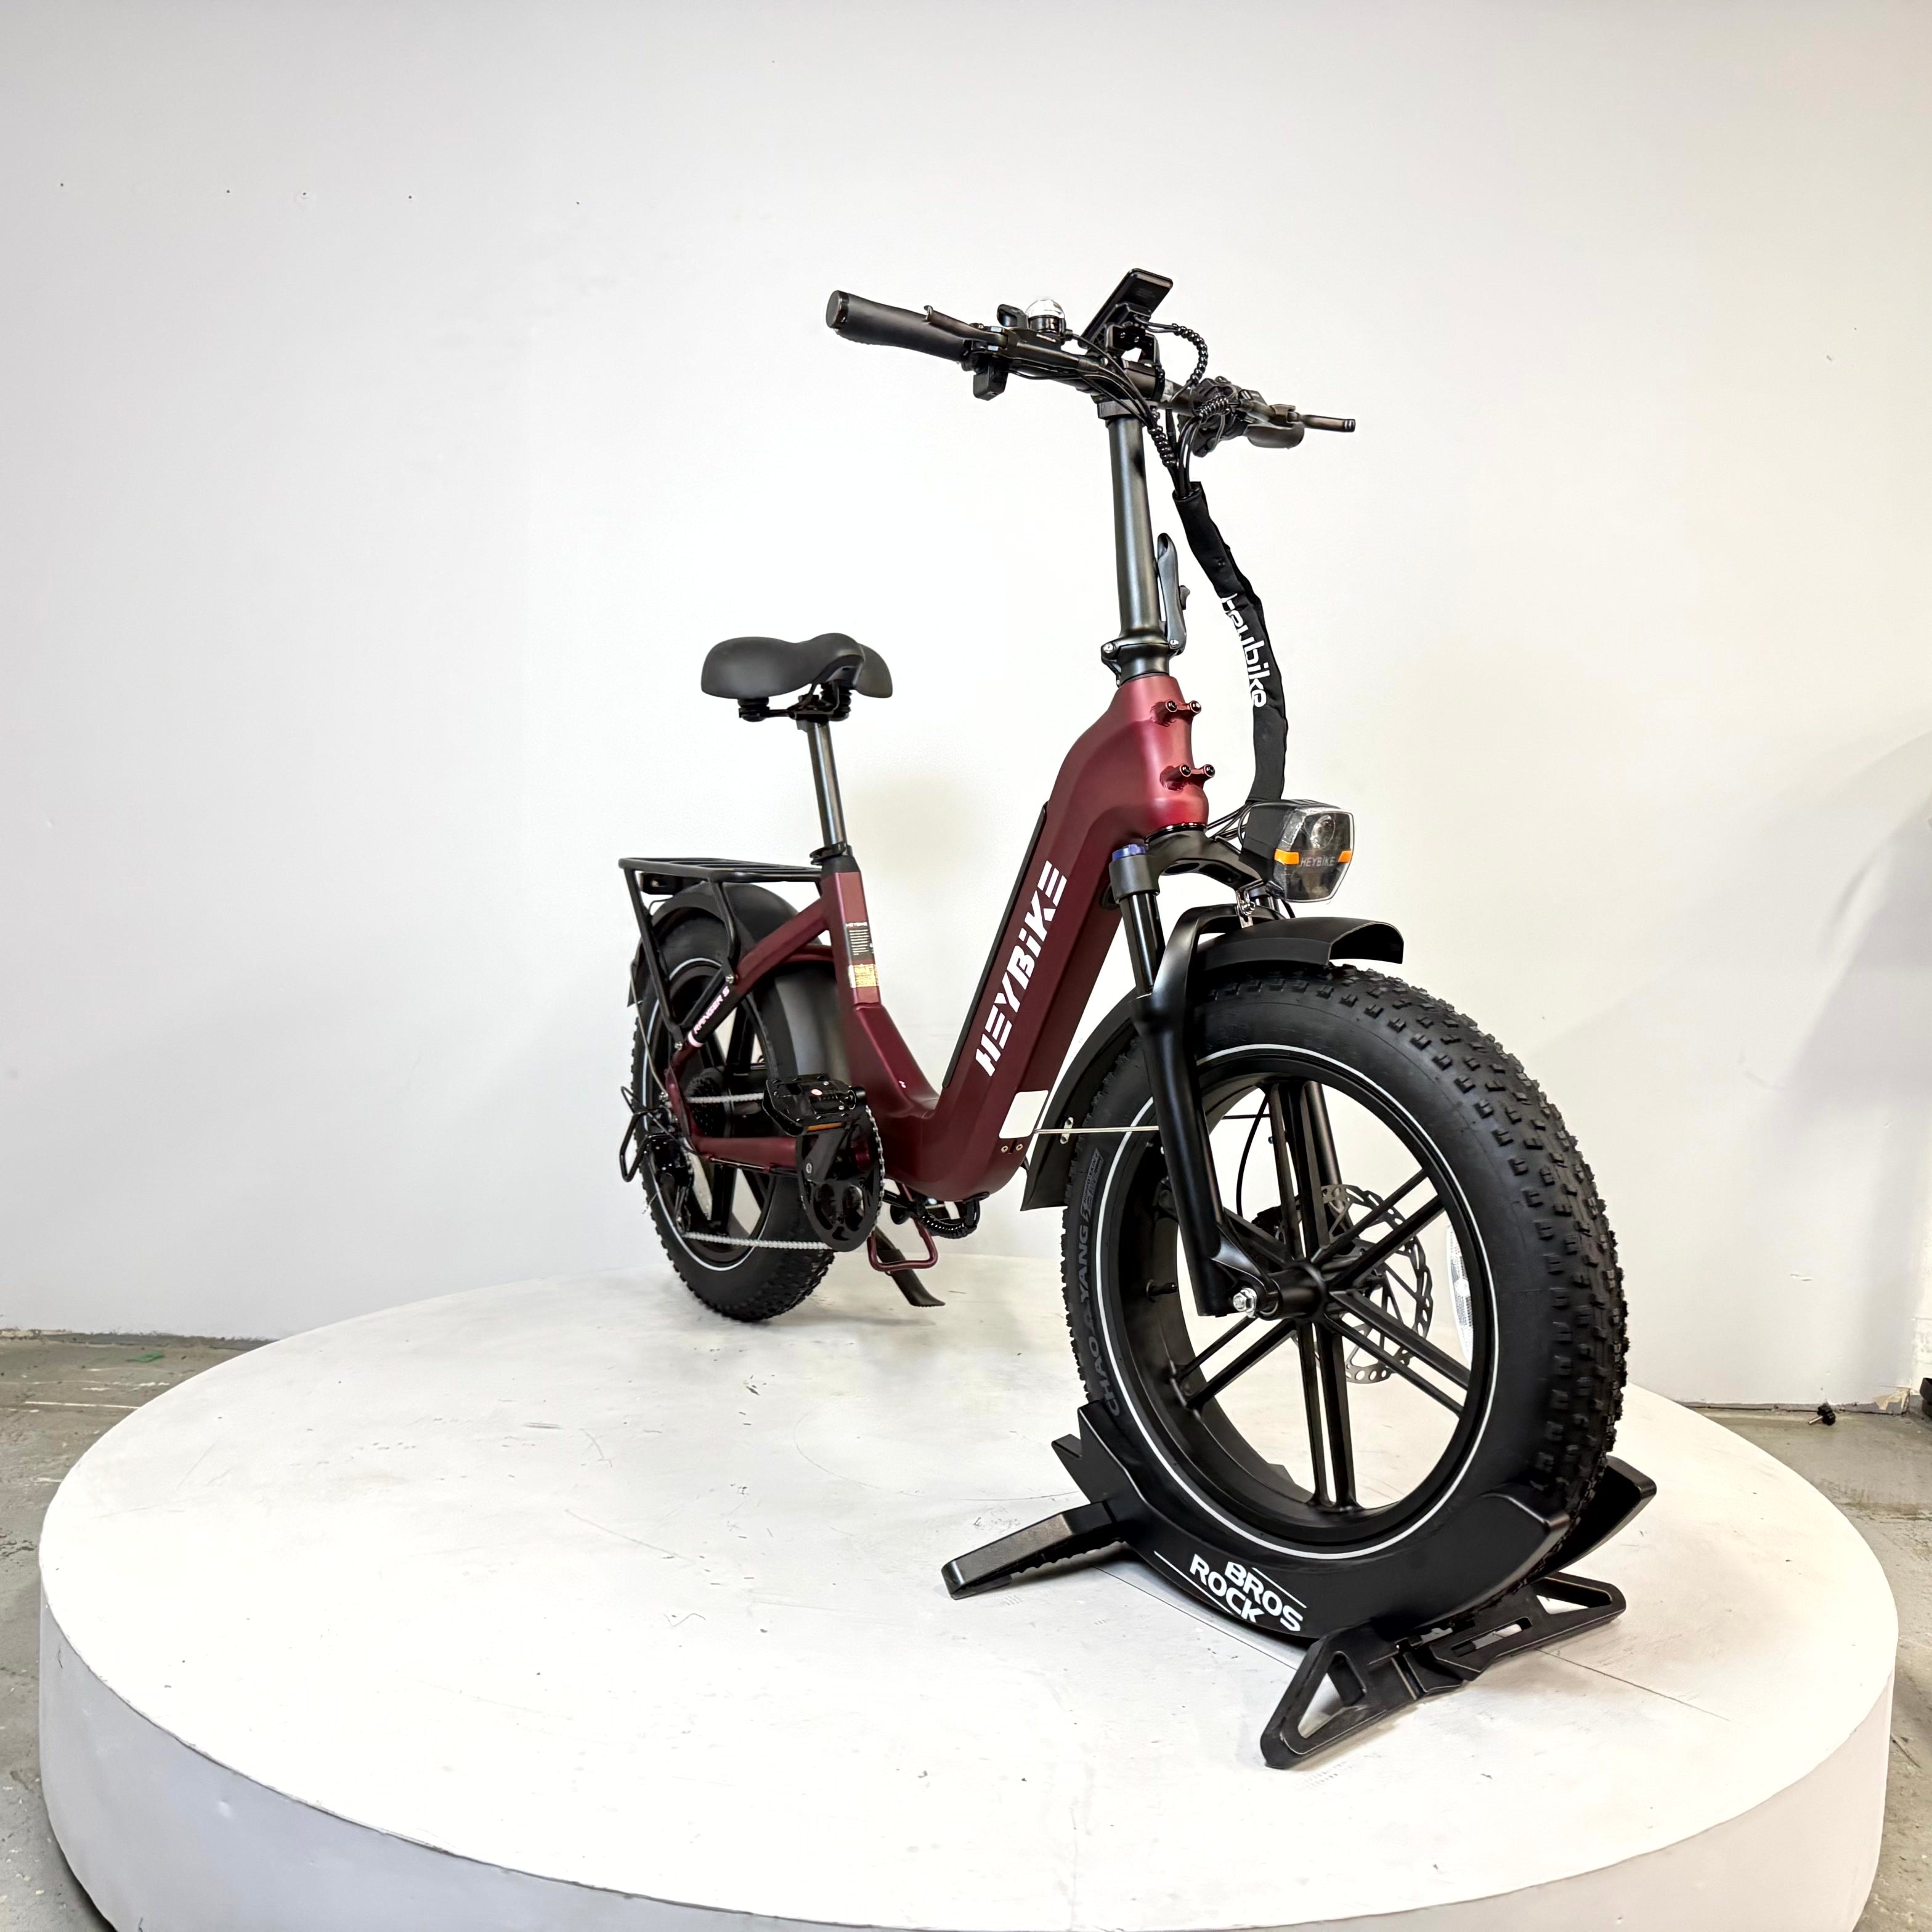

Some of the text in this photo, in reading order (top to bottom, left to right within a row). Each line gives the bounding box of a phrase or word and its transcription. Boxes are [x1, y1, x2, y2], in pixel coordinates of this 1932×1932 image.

[1078, 1224, 1090, 1303] YANG
[1190, 1554, 1265, 1623] ROCK
[1224, 1561, 1304, 1632] BROS
